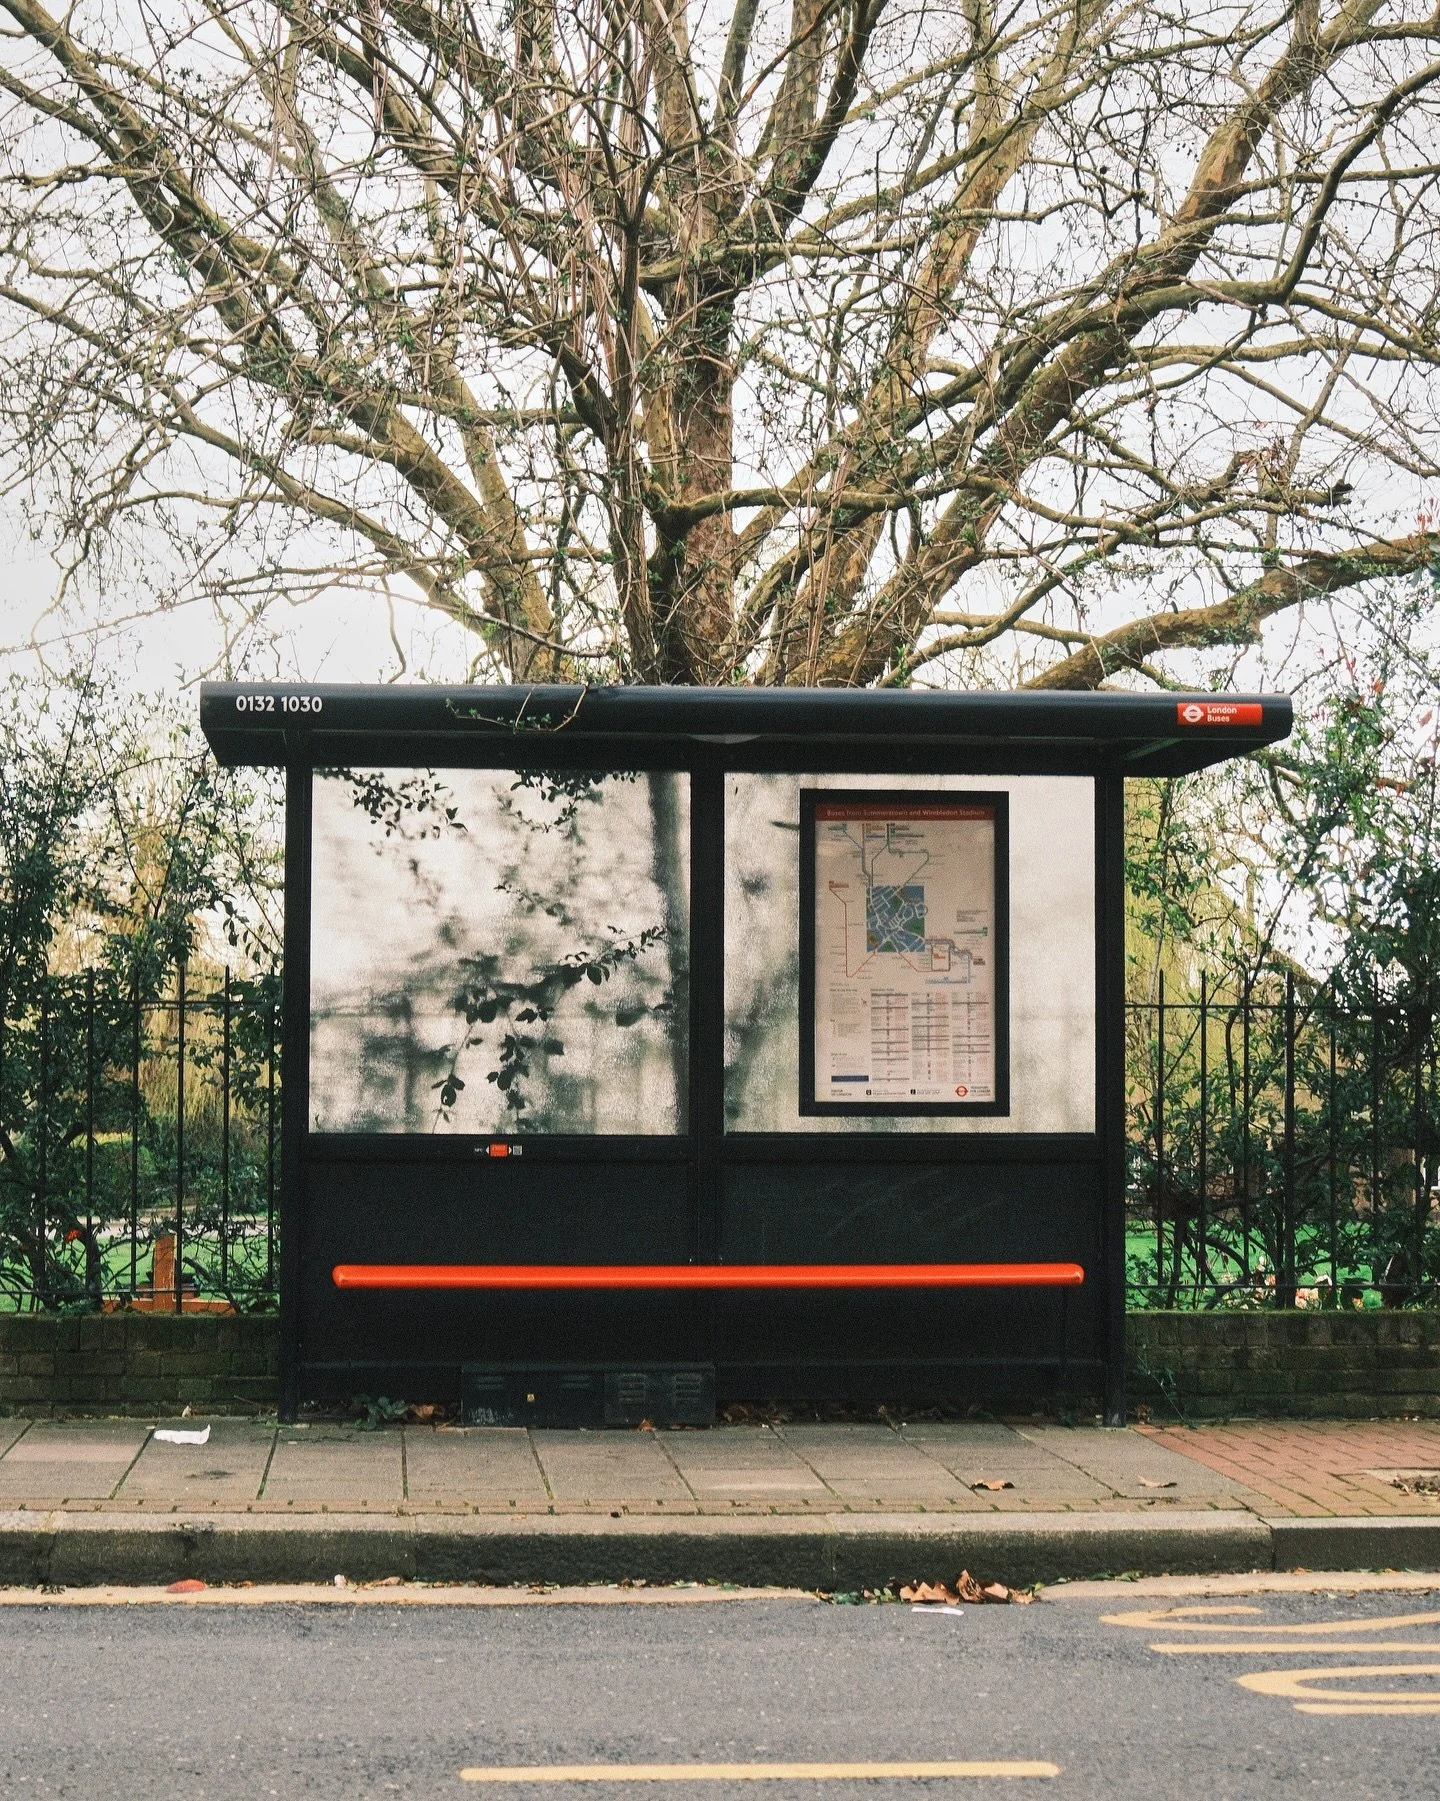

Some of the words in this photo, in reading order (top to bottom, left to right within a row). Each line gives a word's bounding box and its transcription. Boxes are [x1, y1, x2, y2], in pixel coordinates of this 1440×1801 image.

[236, 695, 275, 712] 0132
[281, 696, 322, 713] 1030
[922, 809, 958, 817] Wimbledon
[960, 809, 985, 817] Stadium
